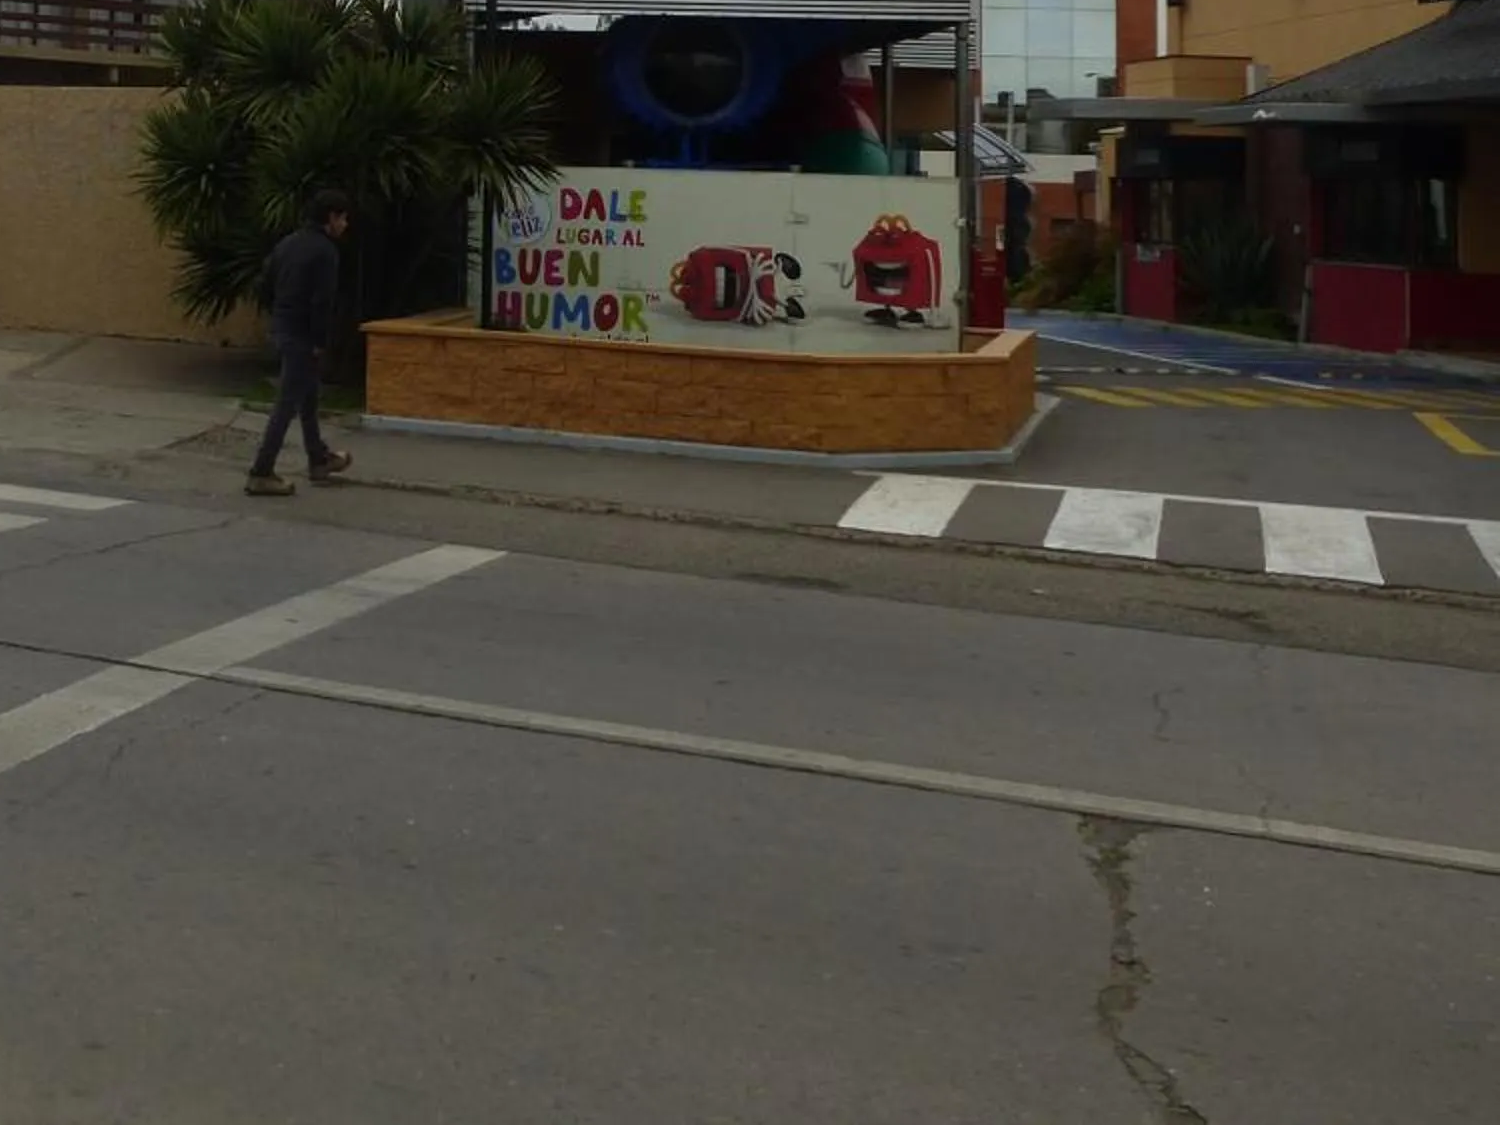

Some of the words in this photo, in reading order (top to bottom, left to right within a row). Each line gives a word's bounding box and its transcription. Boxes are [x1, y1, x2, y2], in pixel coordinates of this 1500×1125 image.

[560, 187, 647, 222] DALE
[556, 228, 617, 246] LUGAR
[622, 229, 645, 247] AL
[494, 248, 599, 287] BUEN
[497, 291, 649, 332] HUMOR
